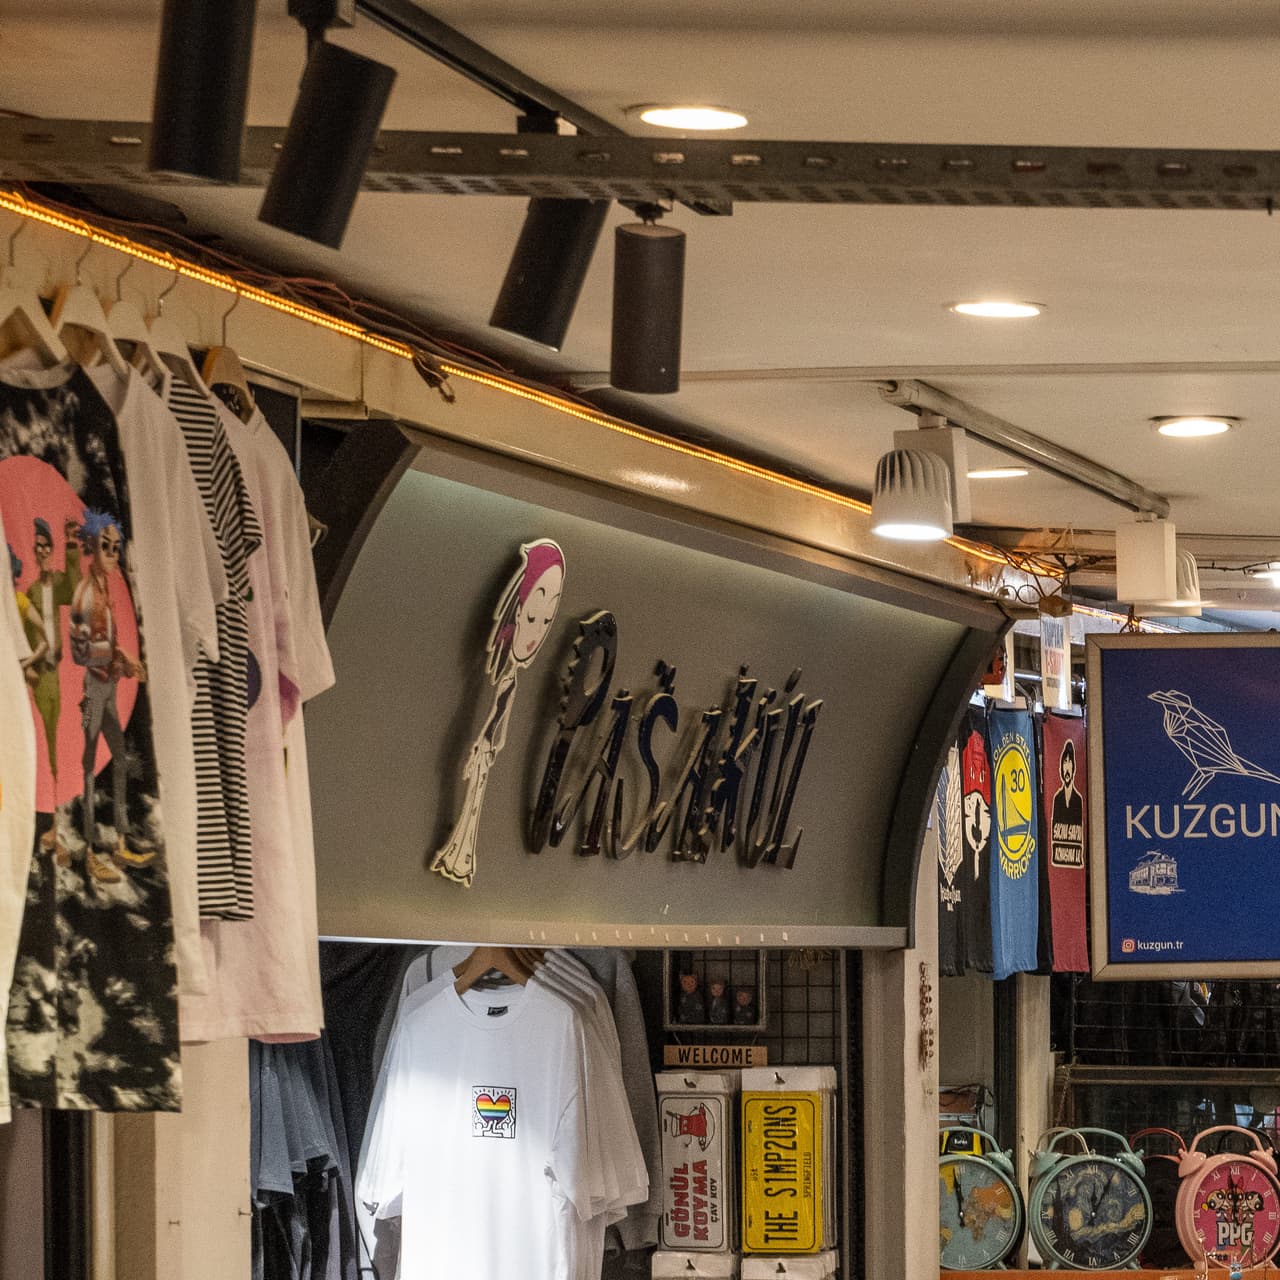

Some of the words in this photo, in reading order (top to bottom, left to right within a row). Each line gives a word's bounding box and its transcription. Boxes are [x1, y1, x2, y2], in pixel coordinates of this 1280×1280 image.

[1010, 769, 1026, 793] 30
[1137, 940, 1184, 953] kuzgun.tr
[678, 1047, 753, 1064] WELCOME
[670, 1162, 690, 1238] GÖNÜL
[692, 1159, 709, 1241] KOYMA
[764, 1210, 799, 1244] THE
[1217, 1222, 1254, 1246] PPG
